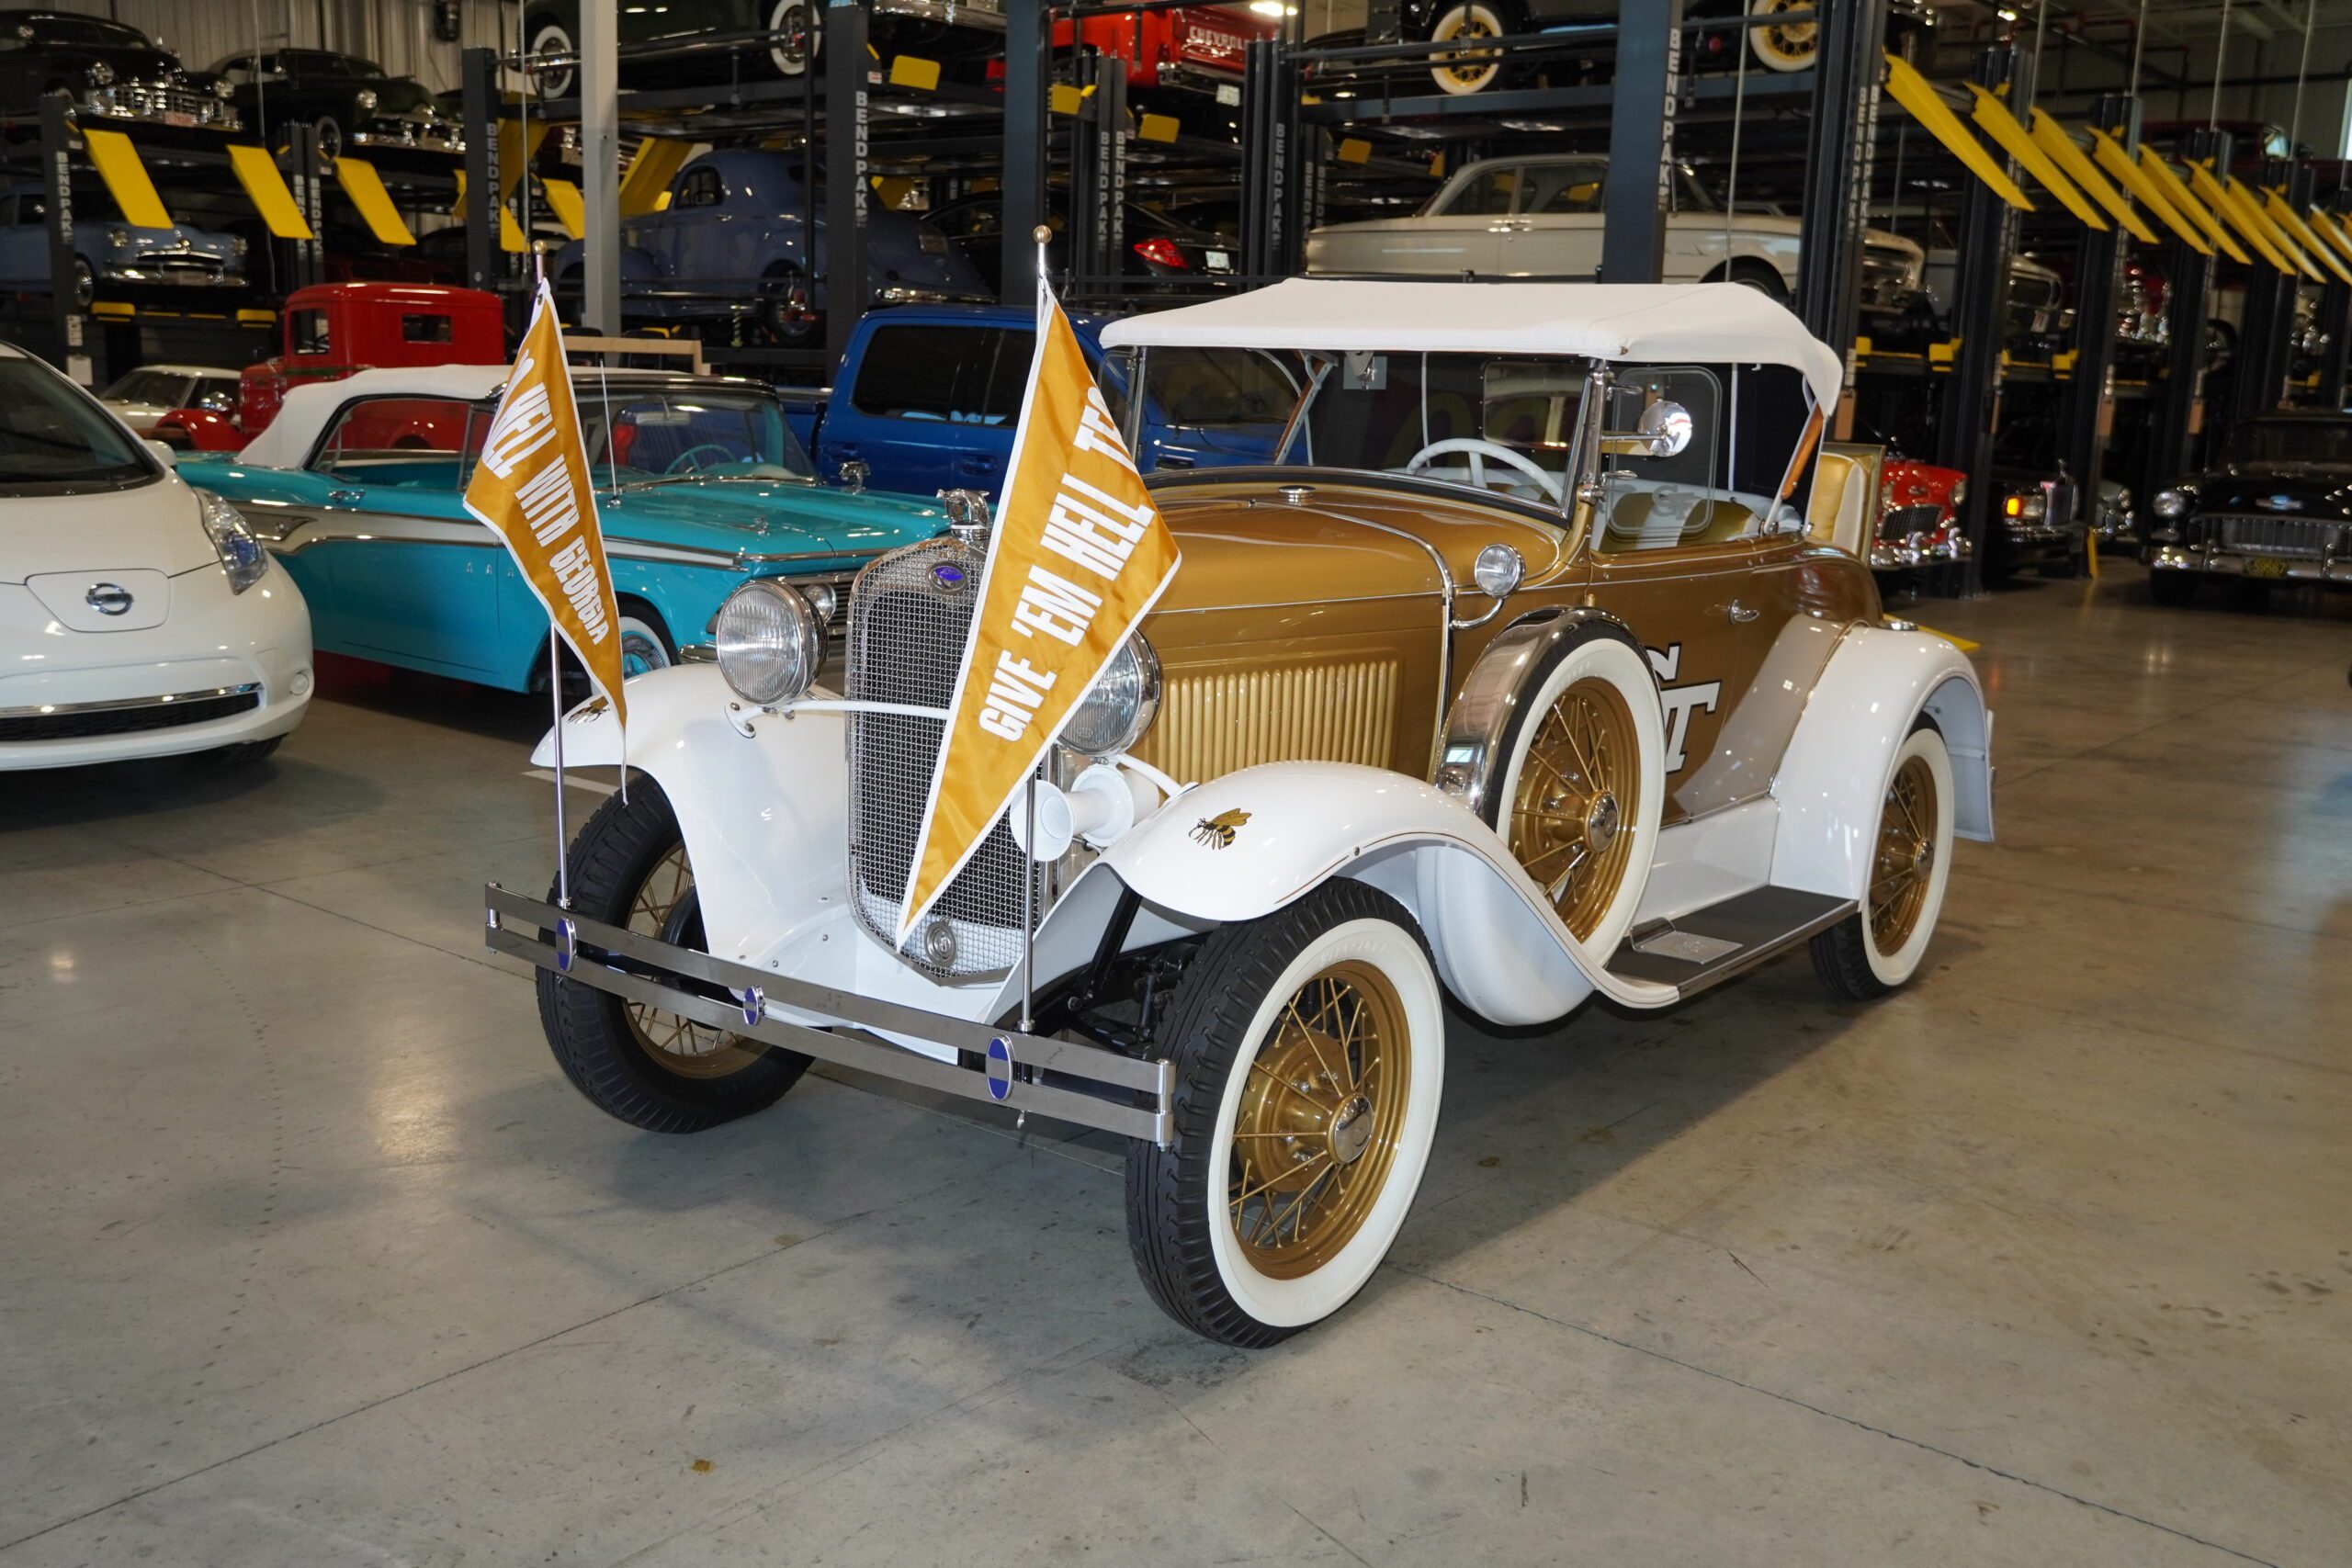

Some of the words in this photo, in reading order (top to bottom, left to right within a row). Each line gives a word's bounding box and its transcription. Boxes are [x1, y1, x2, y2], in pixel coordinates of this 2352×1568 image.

[1189, 26, 1245, 50] CHEVROL
[855, 91, 868, 209] BENDPAK
[1659, 28, 1680, 185] BENDPAK
[1849, 86, 1867, 220] BENDPAK
[1860, 85, 1880, 218] BENDPAK
[56, 151, 73, 231] BENDPAK
[310, 177, 322, 251] BENDPAK
[487, 122, 500, 222] BENDPAK
[1098, 131, 1110, 233] BENDPAK
[1113, 130, 1125, 233] BENDPAK
[1272, 123, 1285, 232] BENDPAK
[481, 382, 557, 479] HELL
[514, 452, 581, 547] WITH
[1039, 472, 1156, 581] HELL
[548, 542, 611, 645] GEORGIA
[1011, 564, 1103, 647] 'EM
[978, 649, 1058, 742] GIVE
